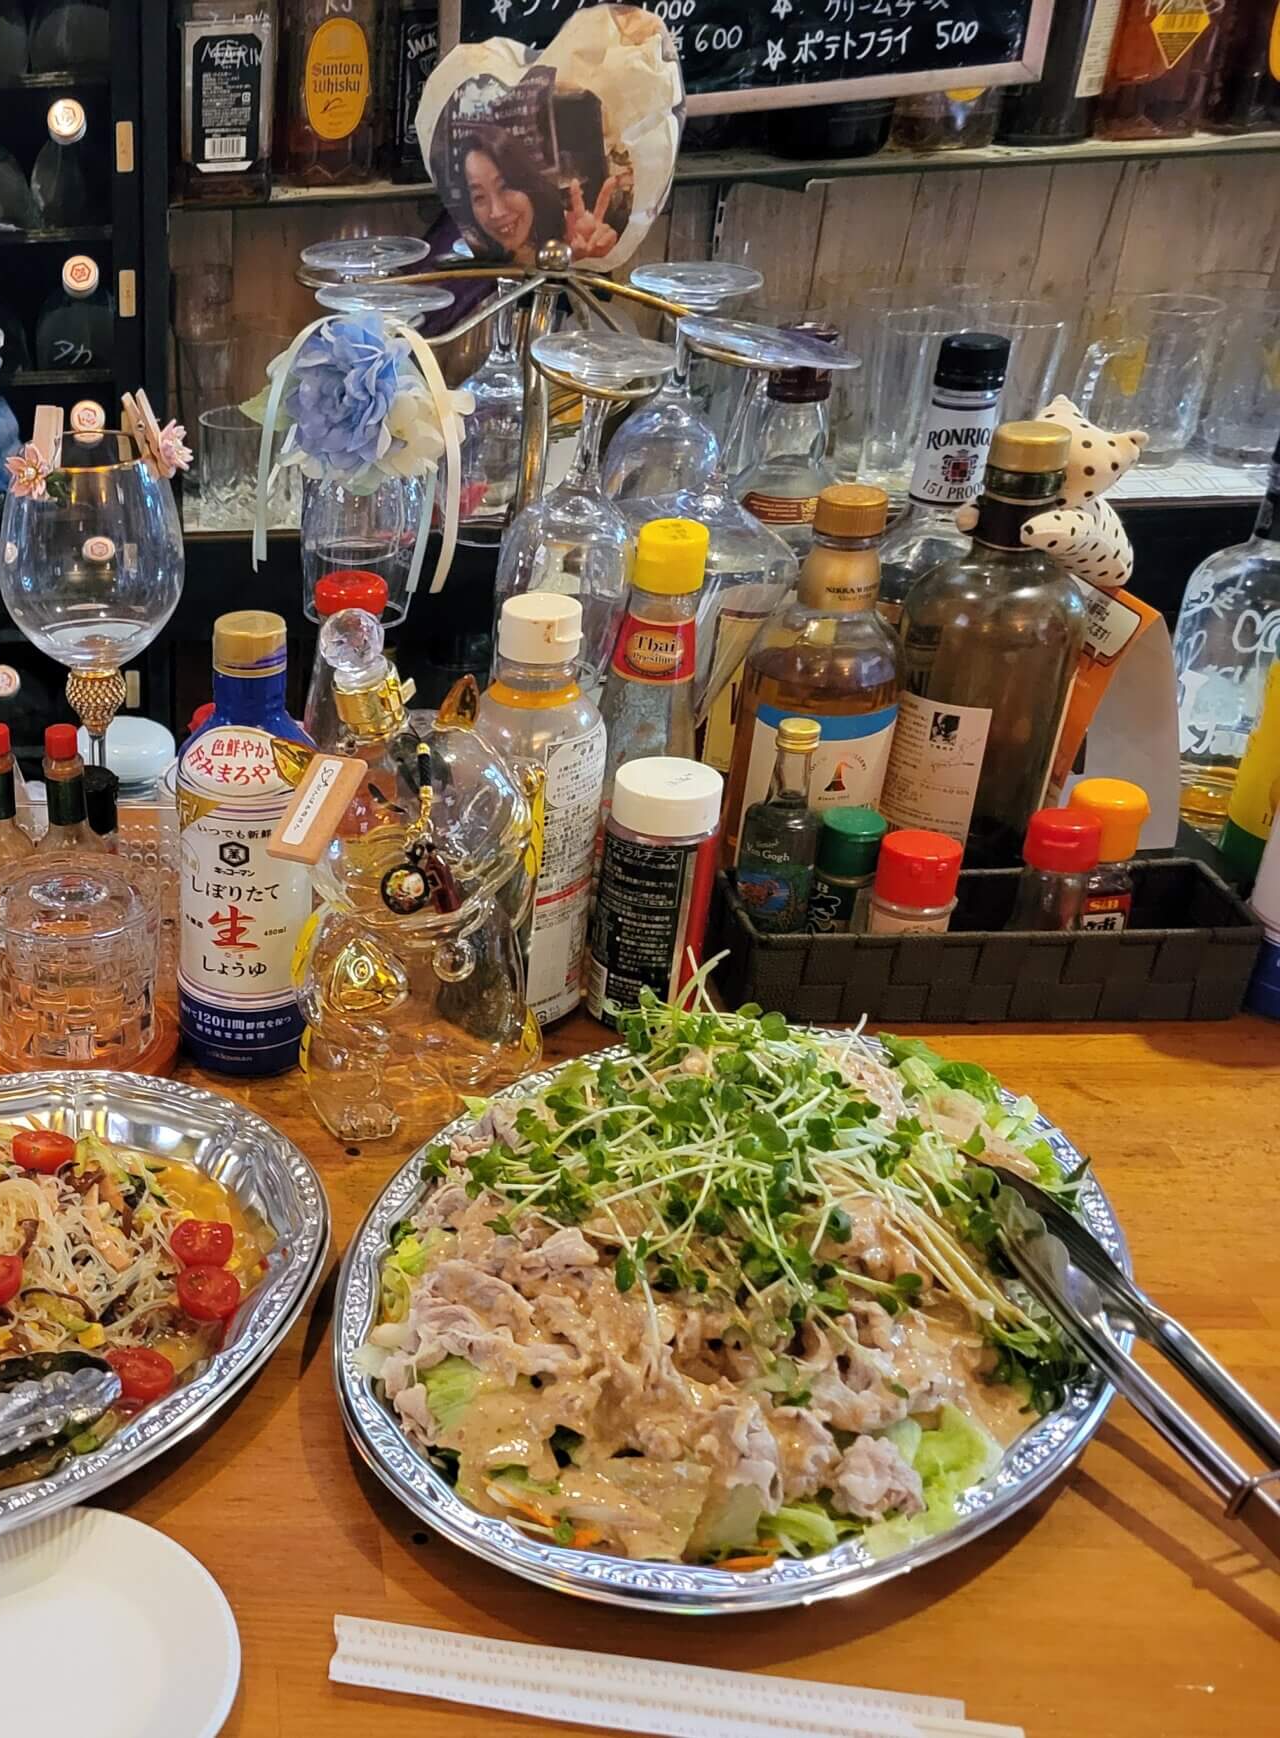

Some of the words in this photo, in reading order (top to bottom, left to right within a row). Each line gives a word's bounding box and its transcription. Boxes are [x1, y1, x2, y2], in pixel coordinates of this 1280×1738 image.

[695, 24, 743, 52] 600
[935, 20, 979, 50] 500
[312, 62, 363, 78] Suntory
[313, 78, 361, 94] Whisky
[922, 479, 943, 497] 151
[947, 482, 983, 500] PROO
[634, 635, 676, 652] Thai
[211, 738, 269, 758] 色鮮やか
[188, 744, 276, 785] 旨みまろや
[762, 850, 790, 864] Gogh
[214, 867, 255, 877] キッコーマン
[192, 874, 279, 902] しぼりたて
[208, 904, 260, 951] 生
[203, 955, 267, 977] しょうゆ
[358, 1625, 408, 1641] ENJOY
[418, 1634, 462, 1648] YOUR
[471, 1641, 513, 1656] MEAL
[339, 1654, 391, 1670] ENJOY
[402, 1663, 446, 1678] YOUR
[456, 1671, 500, 1686] MEAL
